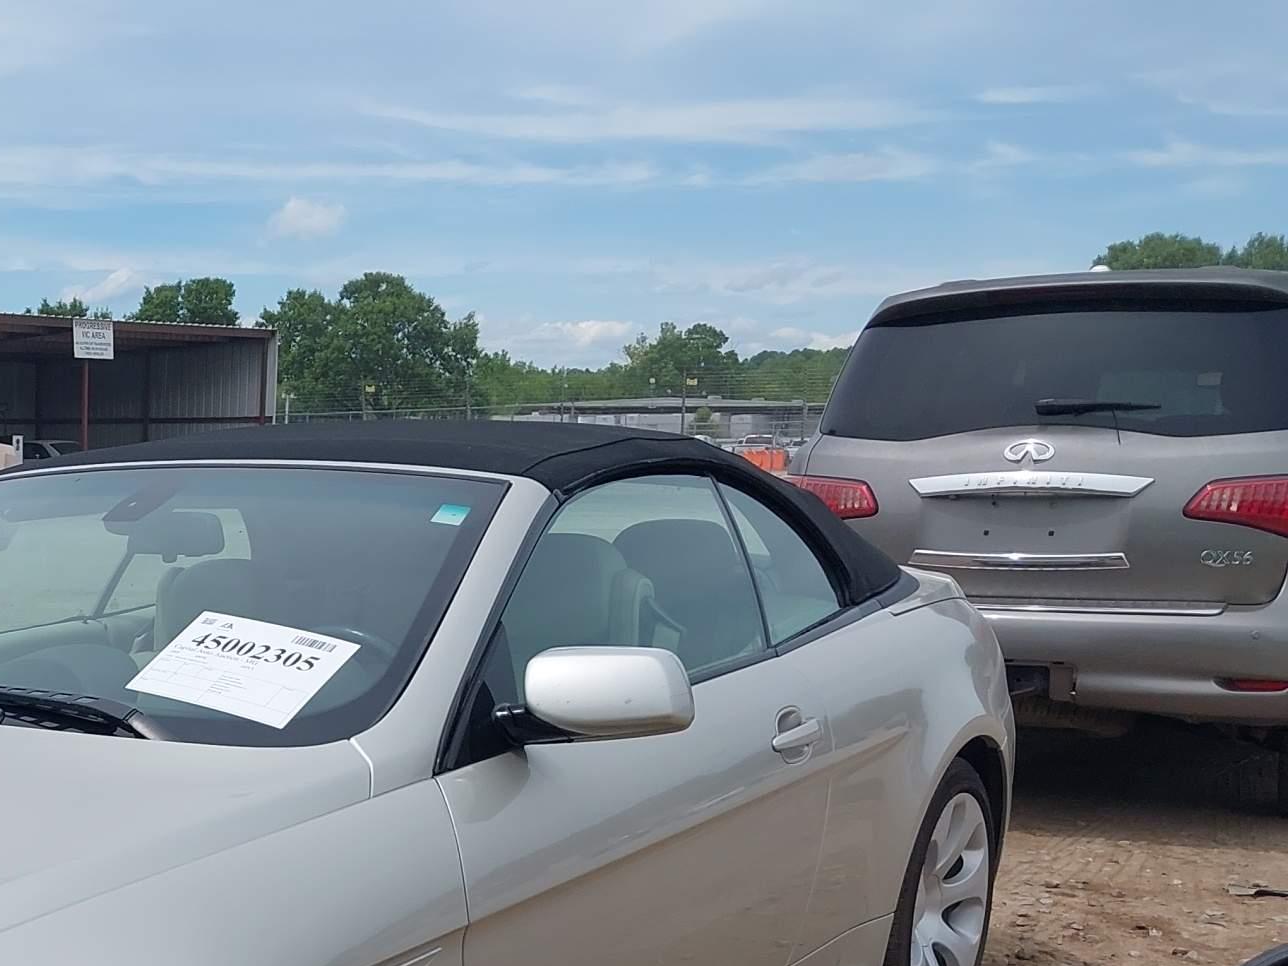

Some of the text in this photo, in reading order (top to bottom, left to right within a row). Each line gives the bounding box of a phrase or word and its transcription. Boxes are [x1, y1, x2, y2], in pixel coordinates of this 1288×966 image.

[91, 331, 106, 340] AREA
[963, 476, 1084, 487] INFINITI
[1200, 550, 1253, 567] QX56
[191, 632, 320, 672] 45002305
